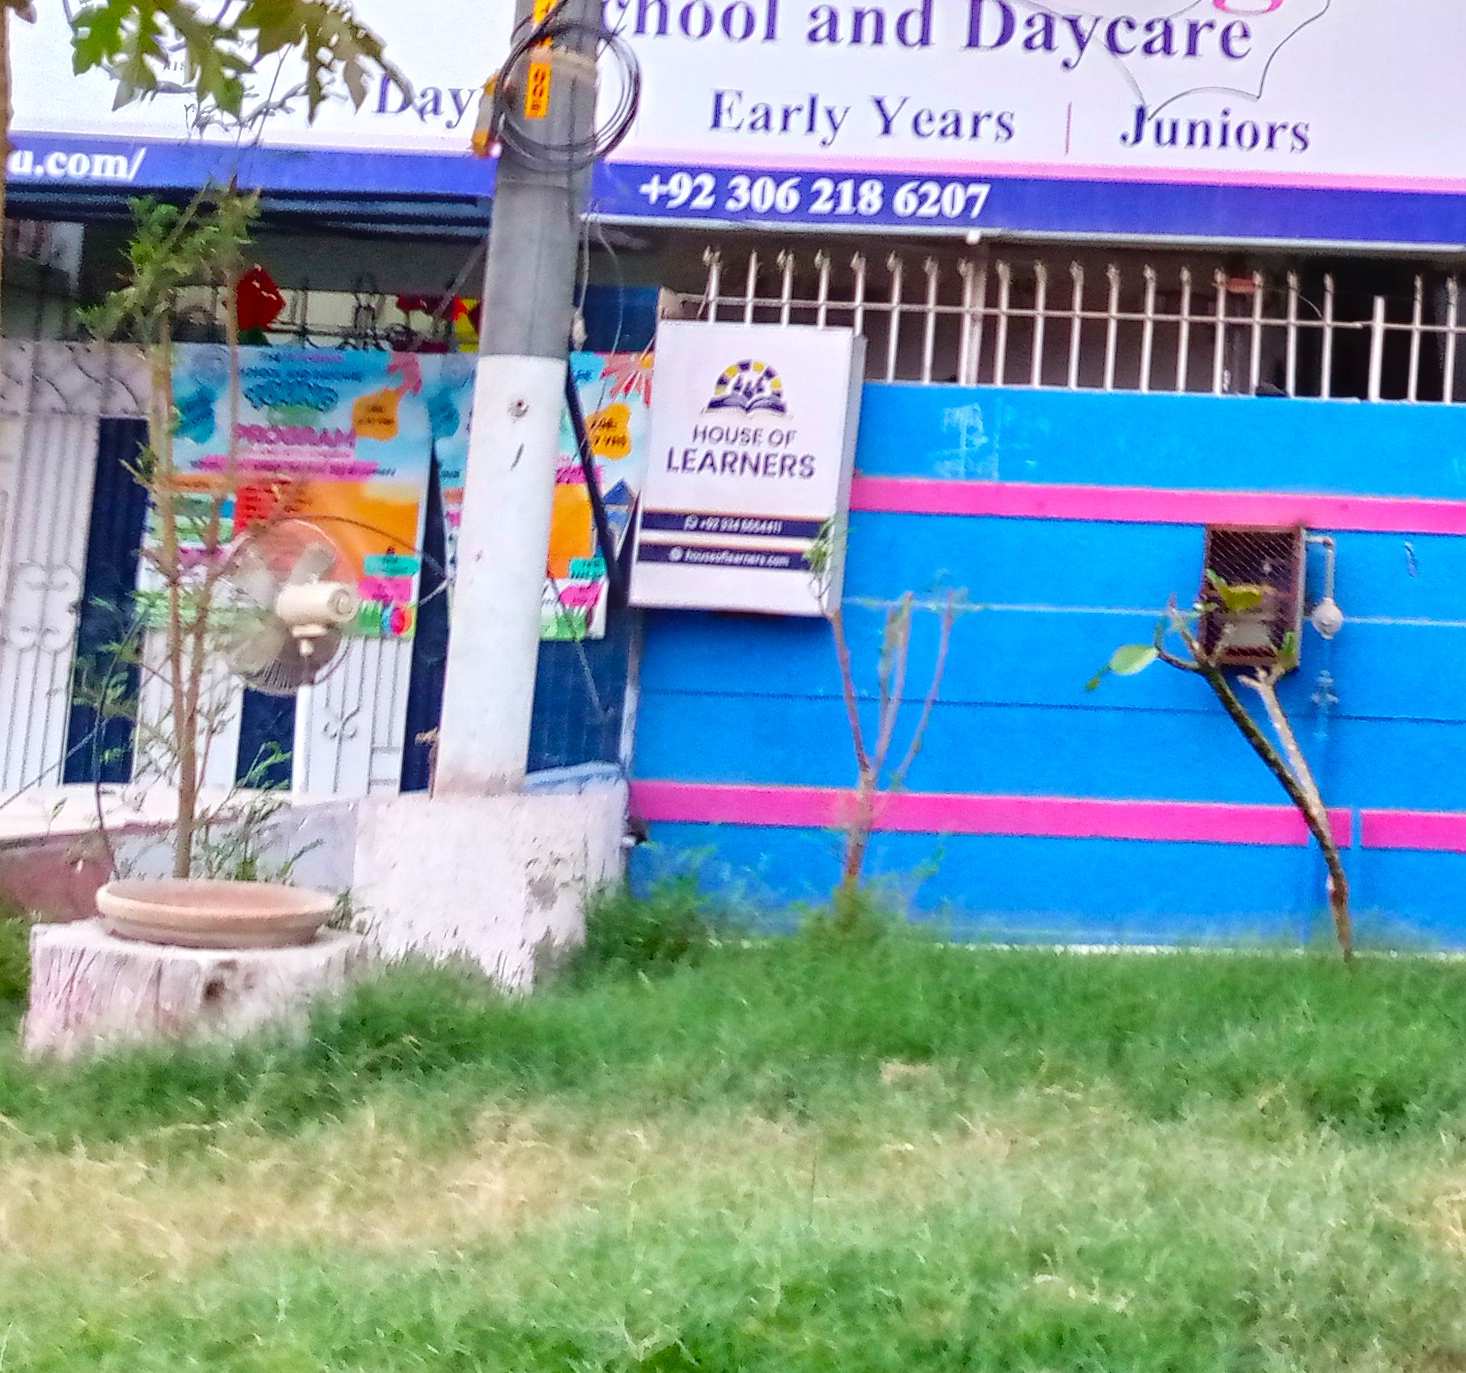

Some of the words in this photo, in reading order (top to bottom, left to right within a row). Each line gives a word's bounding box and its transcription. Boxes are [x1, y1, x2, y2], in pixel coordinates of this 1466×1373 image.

[709, 89, 849, 146] Early
[872, 97, 1017, 142] Years
[1120, 104, 1312, 154] Juniors
[9, 146, 147, 182] u.com/
[639, 172, 716, 211] +92
[726, 177, 800, 214] 306
[810, 179, 883, 216] 218
[893, 181, 992, 220] 6207
[692, 424, 764, 447] HOUSE
[768, 428, 798, 448] OF
[666, 446, 816, 480] LEARNERS
